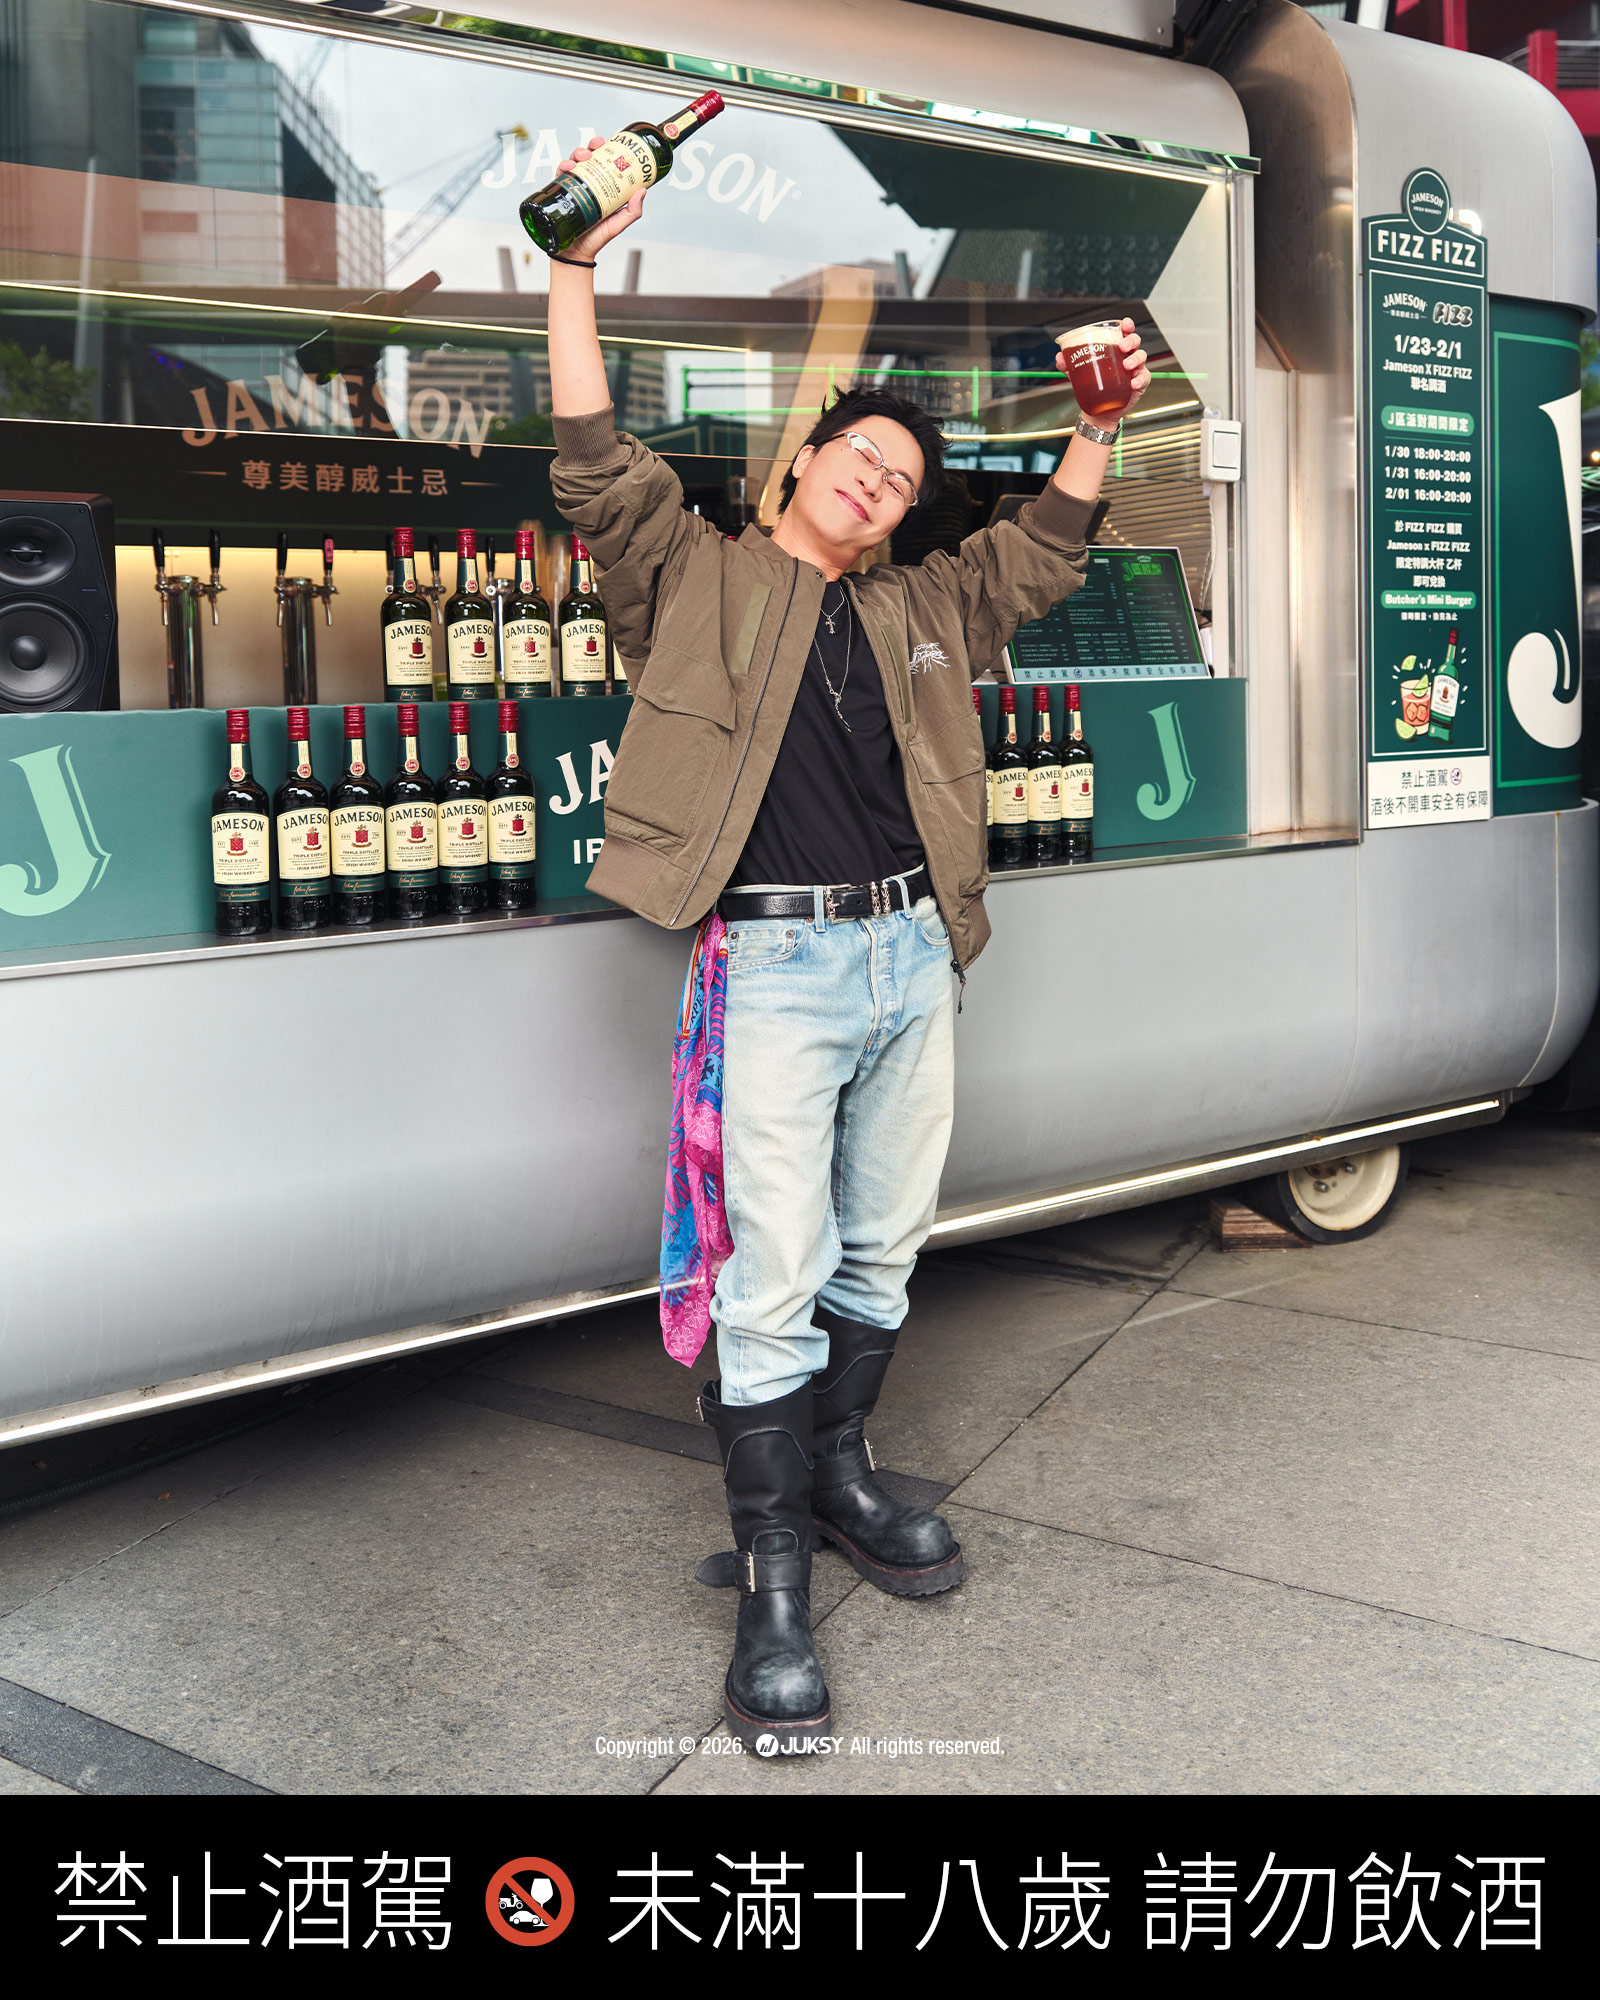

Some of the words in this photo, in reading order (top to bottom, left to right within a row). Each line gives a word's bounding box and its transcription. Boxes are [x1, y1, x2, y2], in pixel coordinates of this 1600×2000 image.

[610, 134, 652, 184] JAMESON
[479, 127, 797, 224] JASON
[1411, 192, 1444, 208] JAMESON
[1378, 230, 1424, 259] FIZZ
[1432, 238, 1476, 268] FIZZ
[1383, 293, 1426, 312] JAMESON
[1433, 302, 1472, 327] FIZZ
[1070, 344, 1104, 363] JAMESON
[1394, 334, 1461, 359] 1/23-2/1
[1383, 359, 1424, 374] Jameson
[1425, 364, 1432, 375] X
[1433, 365, 1452, 377] FIZZ
[1453, 367, 1472, 379] FIZZ
[1411, 376, 1446, 393] 聯名調酒
[182, 373, 495, 458] JAMESON
[1385, 445, 1410, 458] 1/30
[1414, 447, 1471, 463] 18:00-20:00
[242, 460, 448, 496] 尊美醇威士忌
[1385, 466, 1409, 479] 1/31
[1414, 468, 1471, 483] 16:00-20:00
[1385, 487, 1409, 500] 2/01
[1414, 489, 1471, 504] 16:00-20:00
[1405, 522, 1424, 532] FIZZ
[1426, 523, 1445, 533] FIZZ
[1387, 539, 1422, 550] Jameson
[1431, 541, 1450, 551] FIZZ
[1452, 542, 1470, 552] FIZZ
[1385, 594, 1426, 605] Butcher's
[1427, 594, 1444, 605] Mini
[1445, 595, 1472, 607] Burger
[390, 624, 432, 639] JAMESO
[453, 624, 494, 638] JAMESO
[506, 624, 550, 638] JAMESON
[566, 624, 605, 638] JAMESO
[1136, 701, 1196, 820] J
[997, 772, 1027, 784] JAMES
[1033, 770, 1060, 782] JAMES
[1064, 768, 1094, 780] JAMES
[1402, 769, 1448, 789] 禁止酒駕
[492, 801, 536, 816] JAMESON
[1371, 790, 1488, 816] 酒後不開車安全有保障
[334, 812, 383, 826] JAMESON
[390, 808, 436, 823] JAMESON
[441, 805, 486, 819] JAMESON
[0, 744, 112, 916] J
[213, 818, 264, 833] JAMESON
[284, 813, 328, 830] JAMESO
